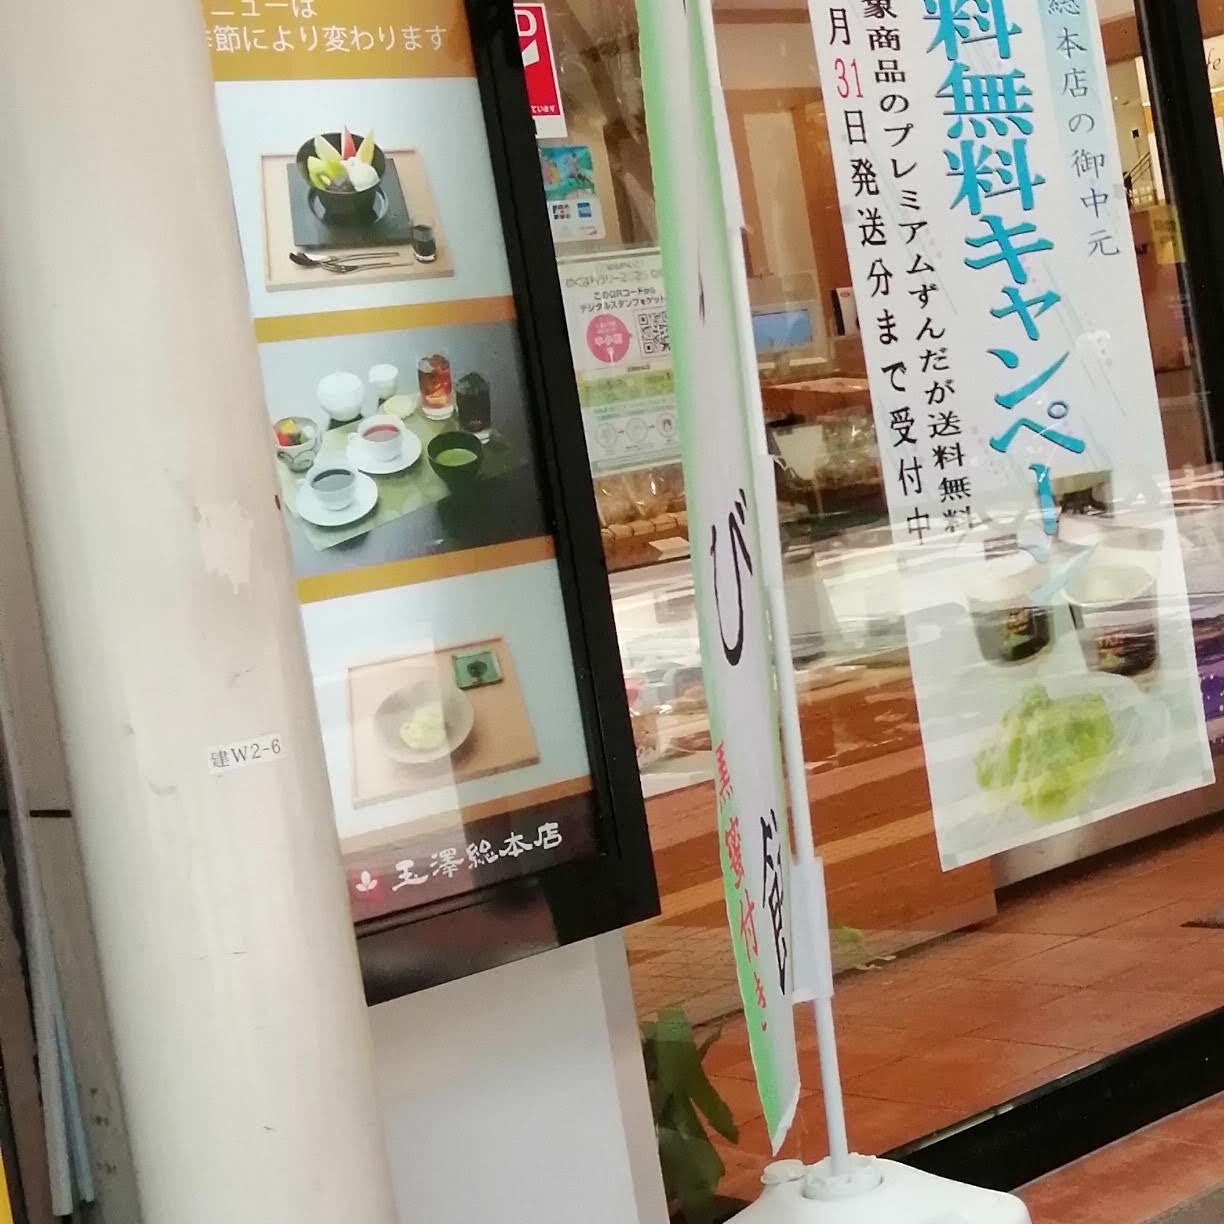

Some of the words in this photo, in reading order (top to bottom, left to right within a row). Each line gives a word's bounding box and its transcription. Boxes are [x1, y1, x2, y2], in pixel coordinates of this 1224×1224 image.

[206, 25, 447, 53] 節により変わります
[391, 822, 563, 892] 玉澤総本店
